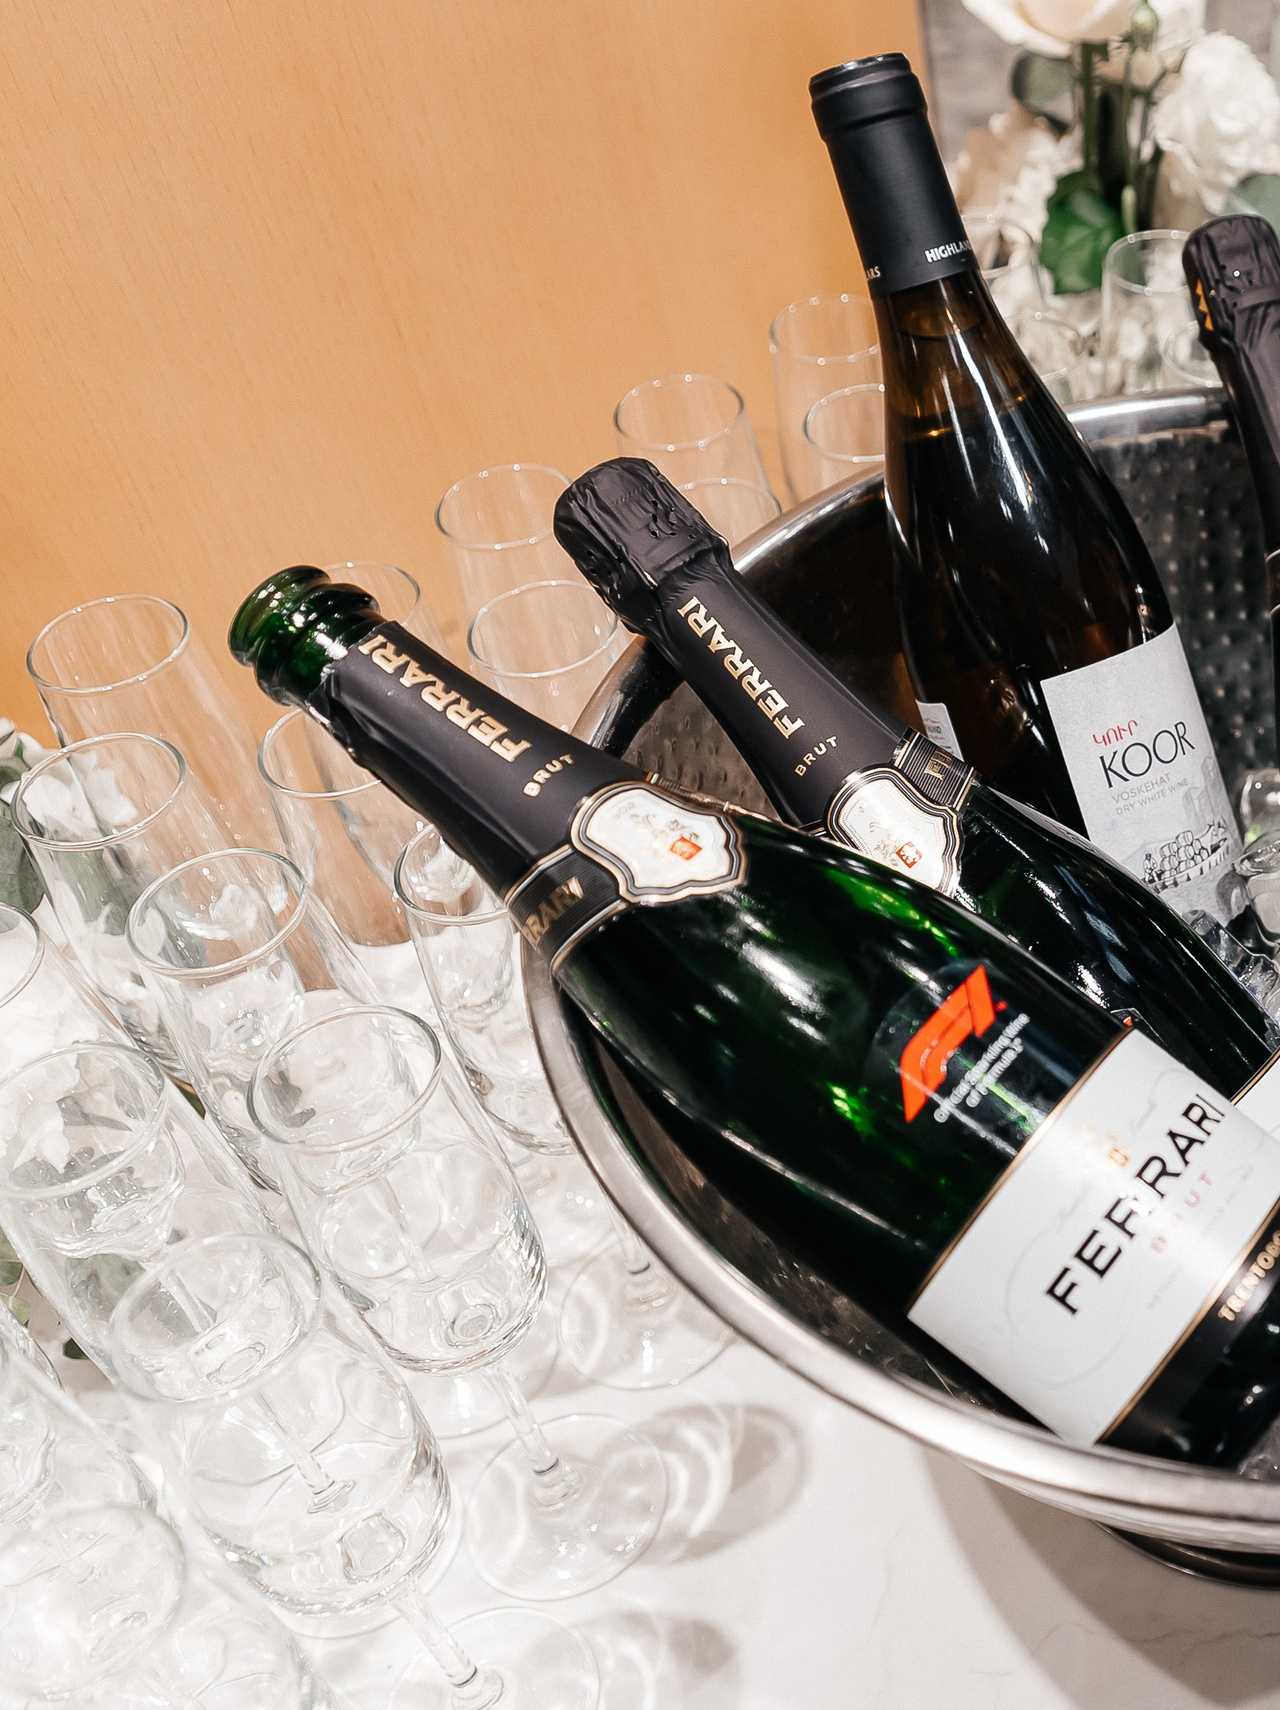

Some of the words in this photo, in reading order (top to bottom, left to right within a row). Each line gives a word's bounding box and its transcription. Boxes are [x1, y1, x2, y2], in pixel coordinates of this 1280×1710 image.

[678, 595, 806, 741] FERRARI
[357, 634, 532, 764] FERRARI
[522, 752, 576, 797] BRUT
[794, 734, 839, 777] BRUT
[1098, 721, 1195, 788] KOOR
[1112, 772, 1172, 803] VOSKEHAT
[1115, 802, 1136, 815] DRY
[1138, 790, 1168, 808] WHITE
[1167, 777, 1189, 794] WINE
[1046, 1094, 1225, 1315] FERRARI
